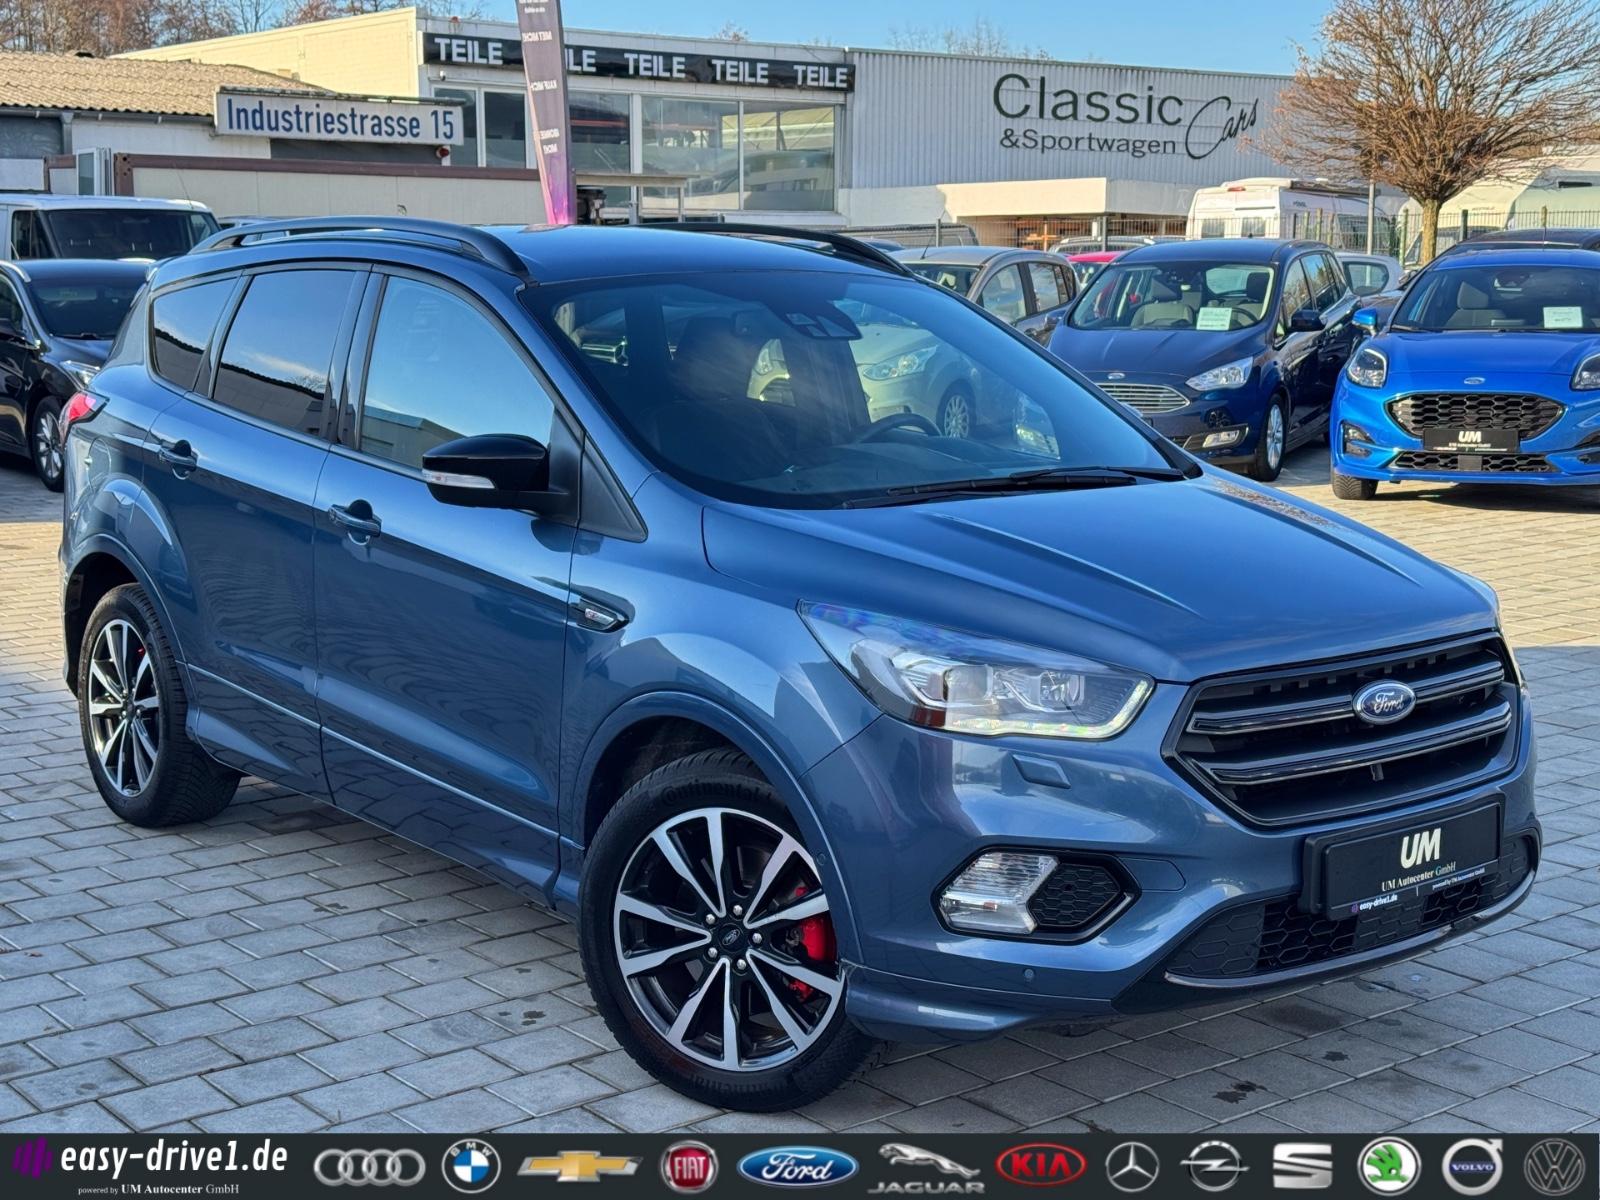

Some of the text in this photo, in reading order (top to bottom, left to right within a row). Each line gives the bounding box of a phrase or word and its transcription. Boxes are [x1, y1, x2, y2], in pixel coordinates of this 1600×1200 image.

[433, 37, 504, 66] TEILE
[564, 47, 597, 73] ILE
[623, 52, 686, 79] TEILE
[711, 59, 769, 84] TEILE
[793, 64, 848, 88] TEILE
[227, 98, 455, 139] Industriestrasse 15
[993, 73, 1259, 160] Classic Cars
[999, 128, 1177, 158] &Sportwagen
[1458, 430, 1482, 442] UM
[1373, 691, 1405, 714] Ford
[1400, 827, 1442, 869] UM
[1381, 879, 1396, 892] UM
[1397, 869, 1435, 888] Autocenter
[1435, 861, 1457, 876] GmbH
